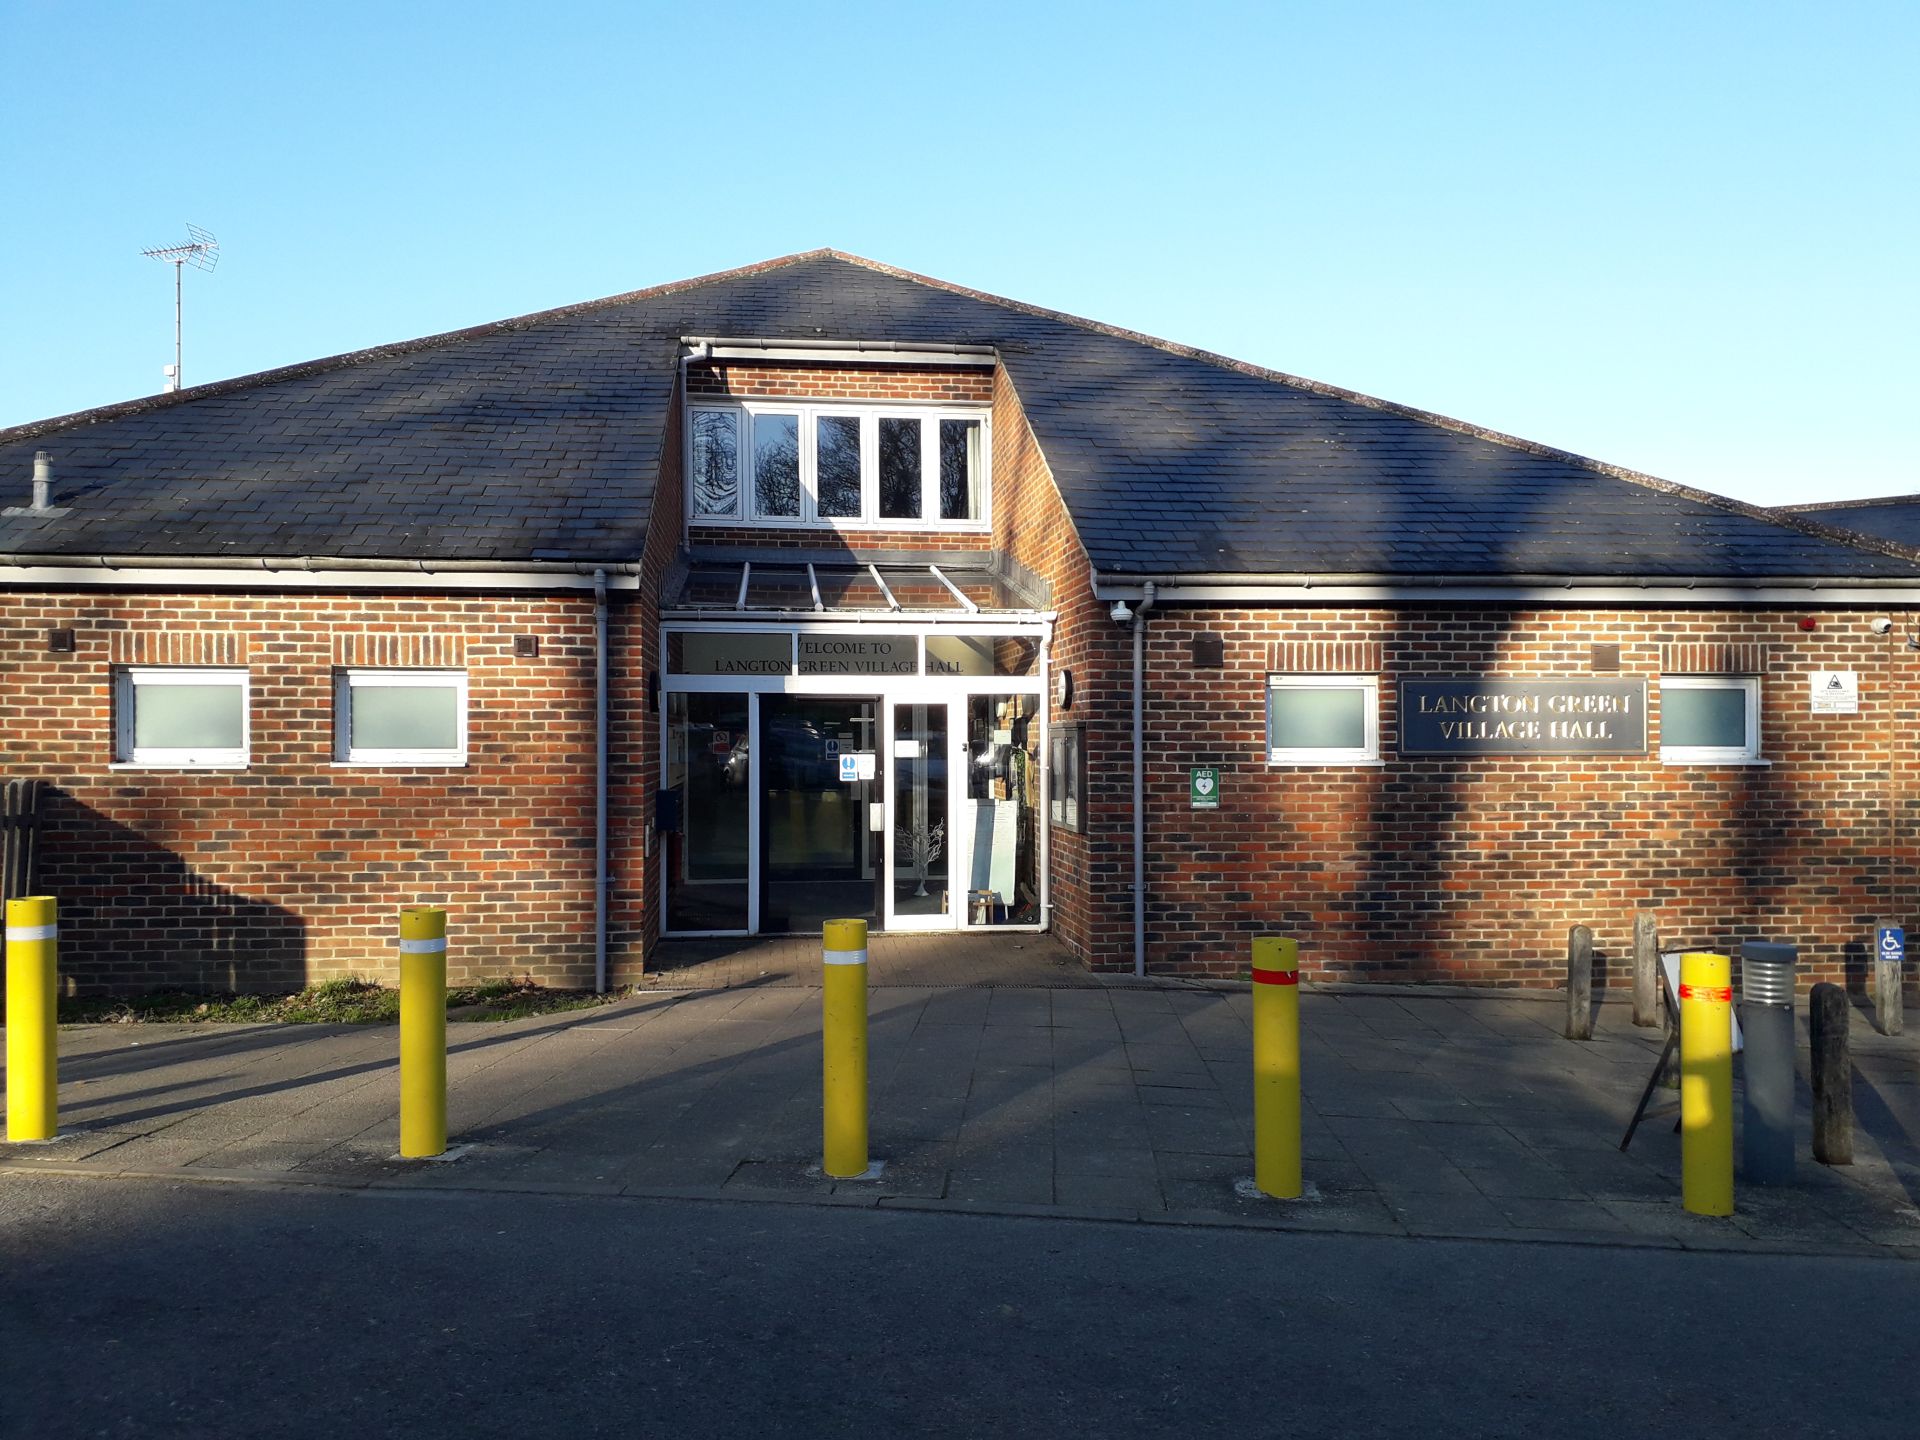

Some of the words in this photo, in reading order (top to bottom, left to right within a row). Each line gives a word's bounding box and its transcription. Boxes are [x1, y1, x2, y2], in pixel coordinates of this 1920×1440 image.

[870, 642, 892, 655] TO
[715, 660, 791, 672] LANGTON
[798, 661, 849, 672] GREEN
[855, 661, 918, 673] VILLAGE
[925, 661, 963, 673] HALL
[1419, 695, 1540, 713] LANGTON
[1547, 695, 1631, 713] GREEN
[1439, 720, 1541, 739] VILLAGE
[1549, 720, 1613, 739] HALL
[1196, 770, 1213, 778] AED
